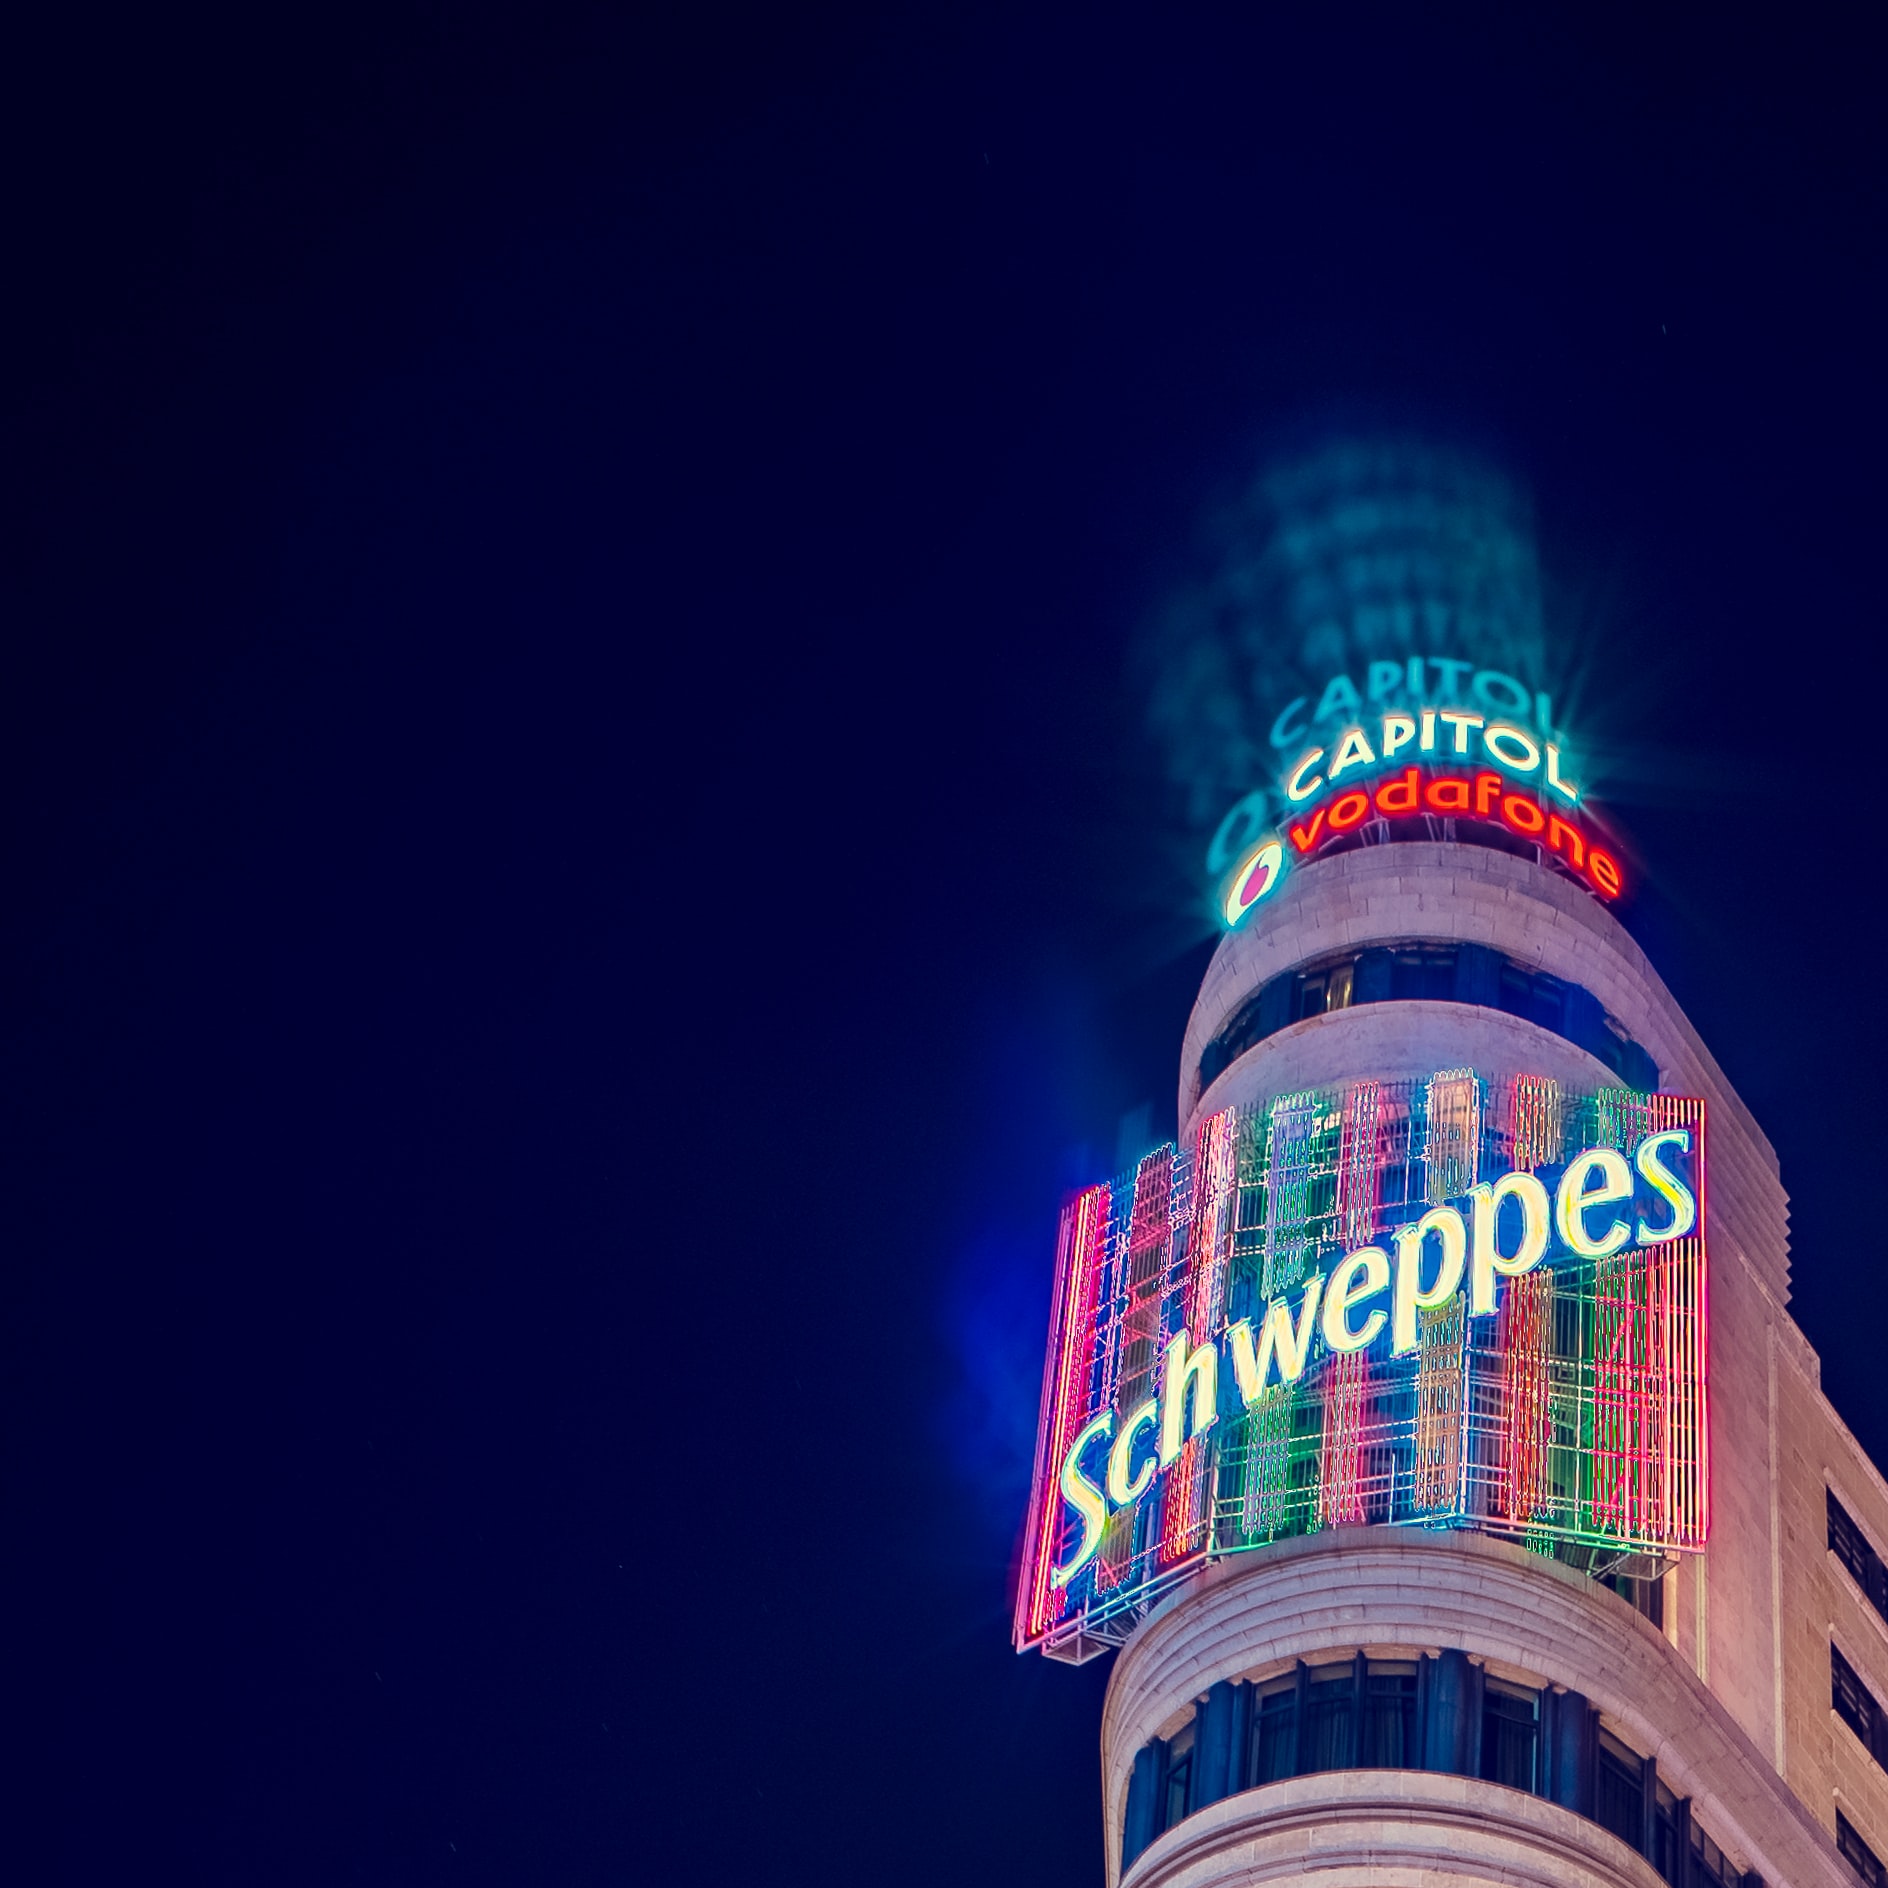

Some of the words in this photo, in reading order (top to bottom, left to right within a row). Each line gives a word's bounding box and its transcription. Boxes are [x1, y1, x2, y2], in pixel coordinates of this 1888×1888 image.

[1286, 711, 1580, 803] CAPITOL
[1289, 766, 1622, 898] vodafone
[1050, 1128, 1698, 1588] Schweppes
